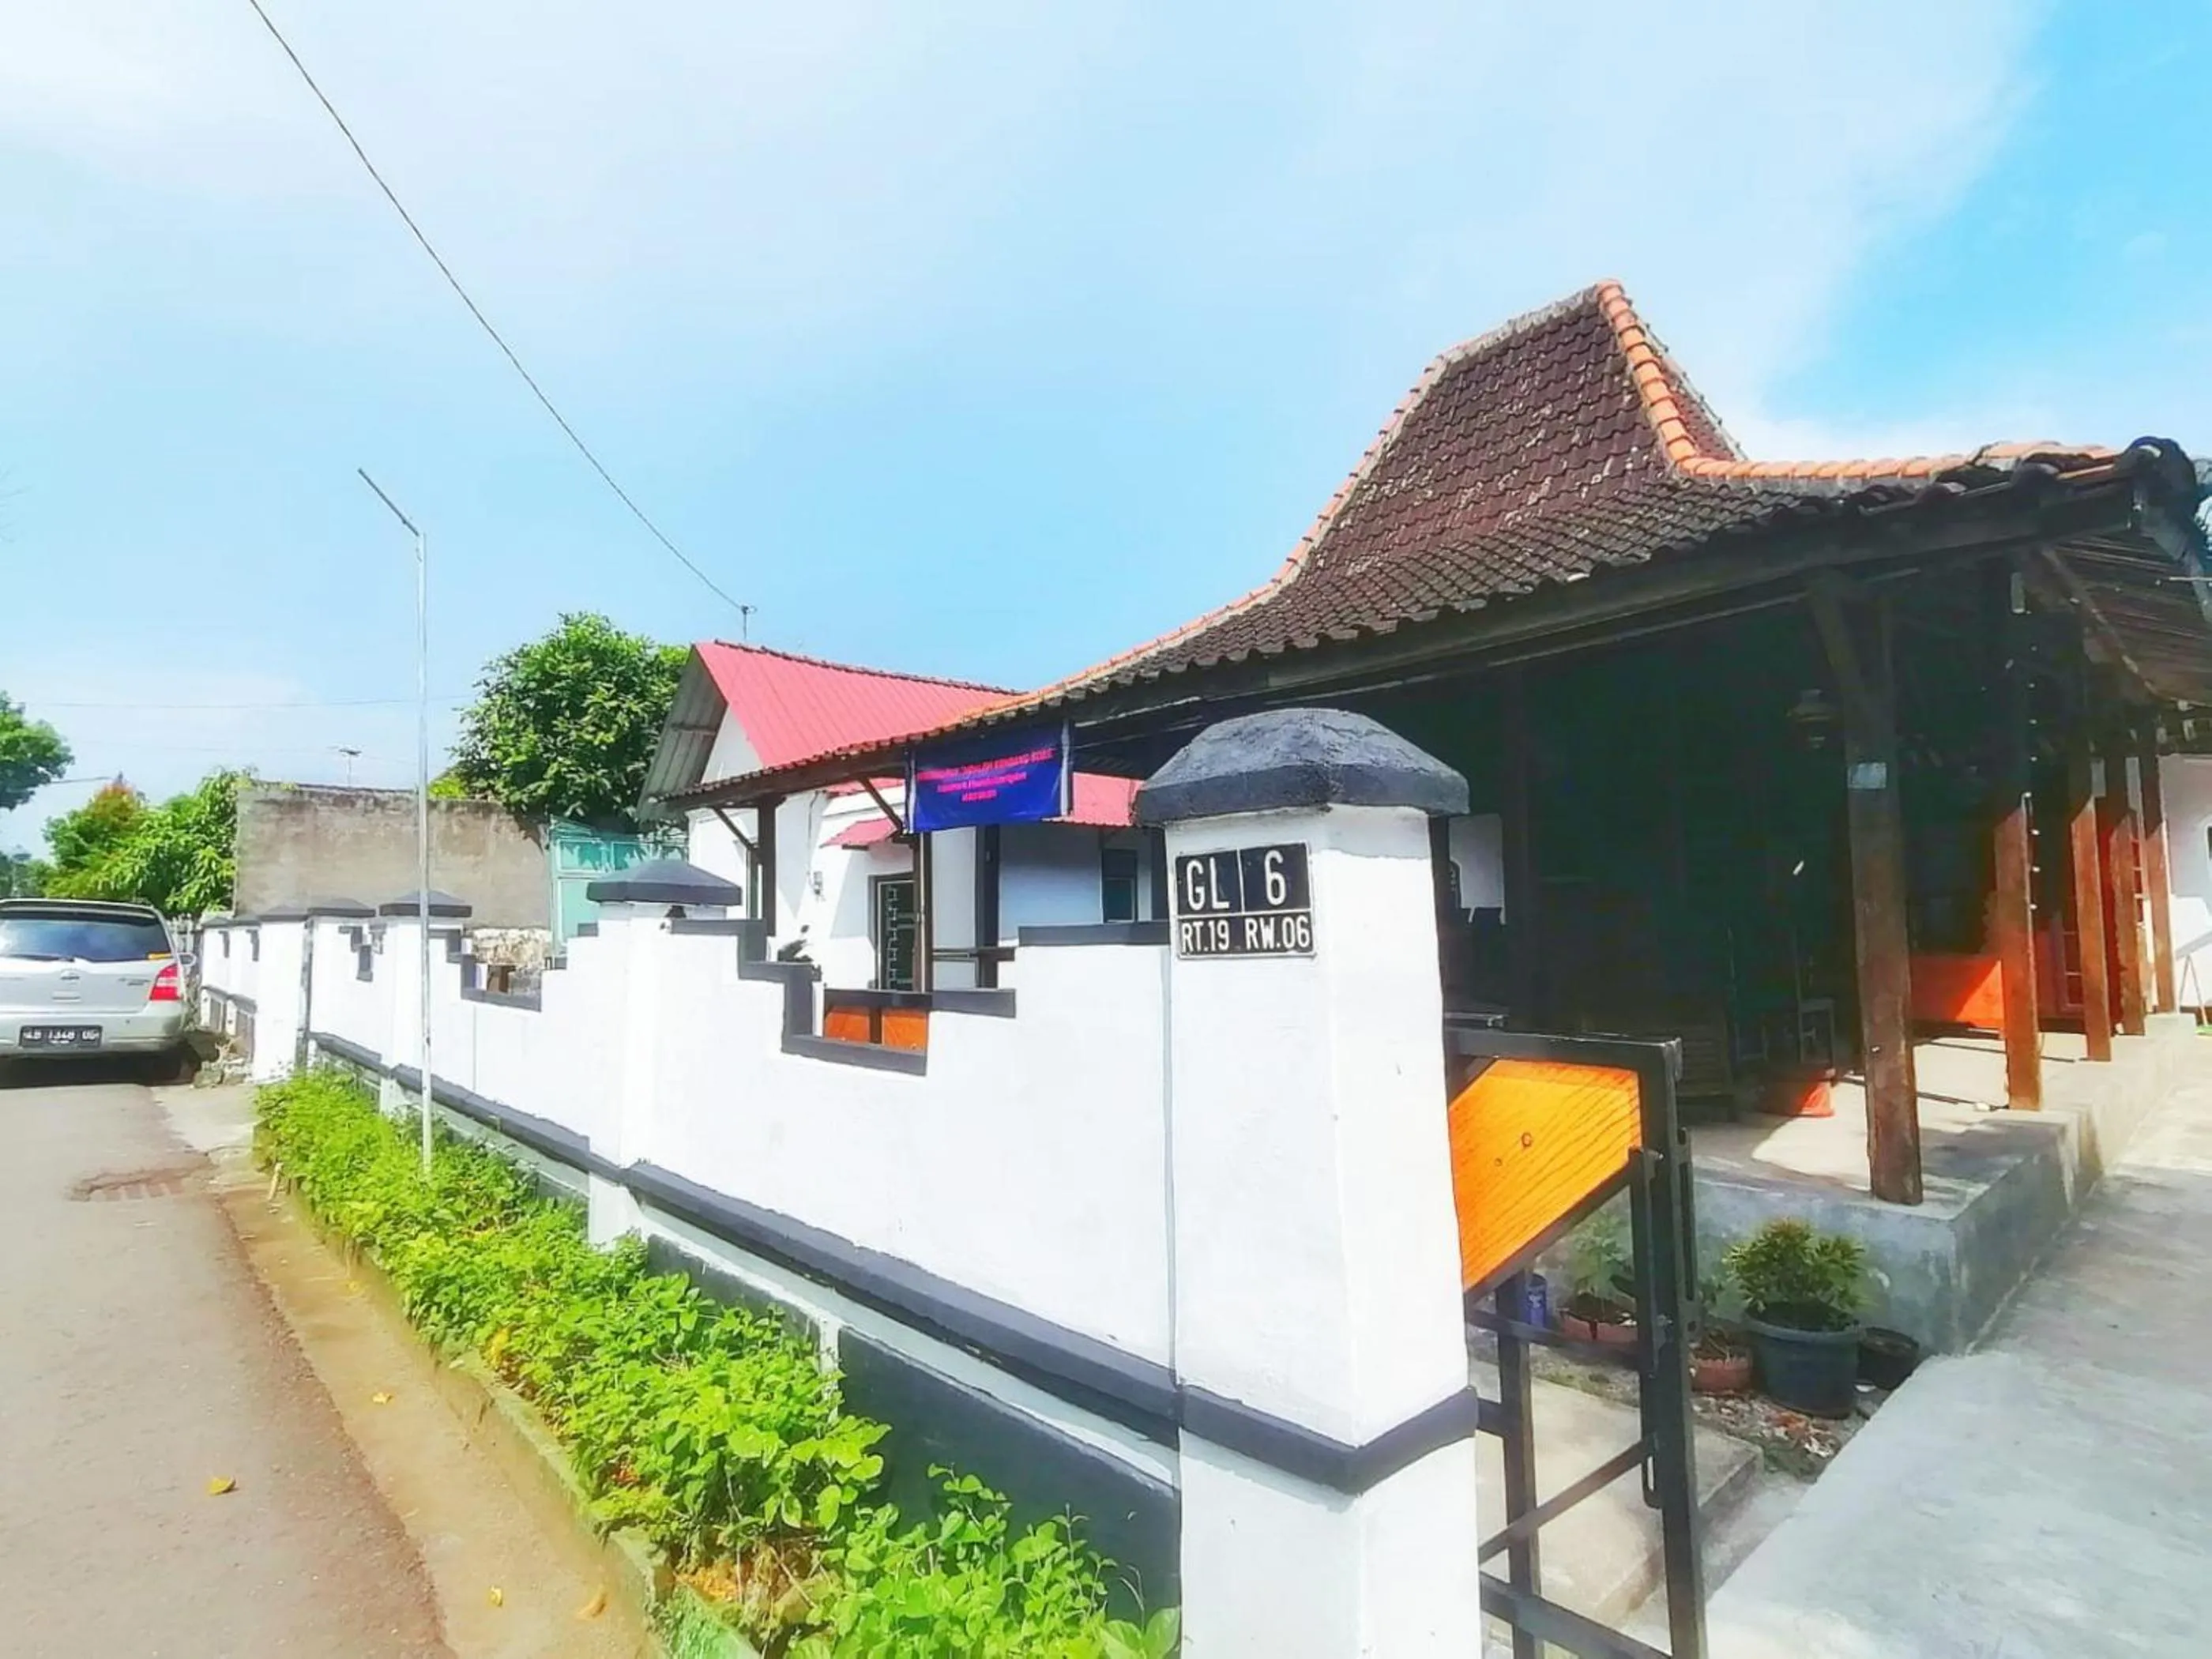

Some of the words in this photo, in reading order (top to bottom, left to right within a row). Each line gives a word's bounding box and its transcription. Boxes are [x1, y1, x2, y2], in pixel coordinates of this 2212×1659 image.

[1186, 856, 1230, 911] GL
[1264, 849, 1286, 906] 6
[1181, 919, 1230, 953] RT.19
[1244, 914, 1311, 950] RW.06
